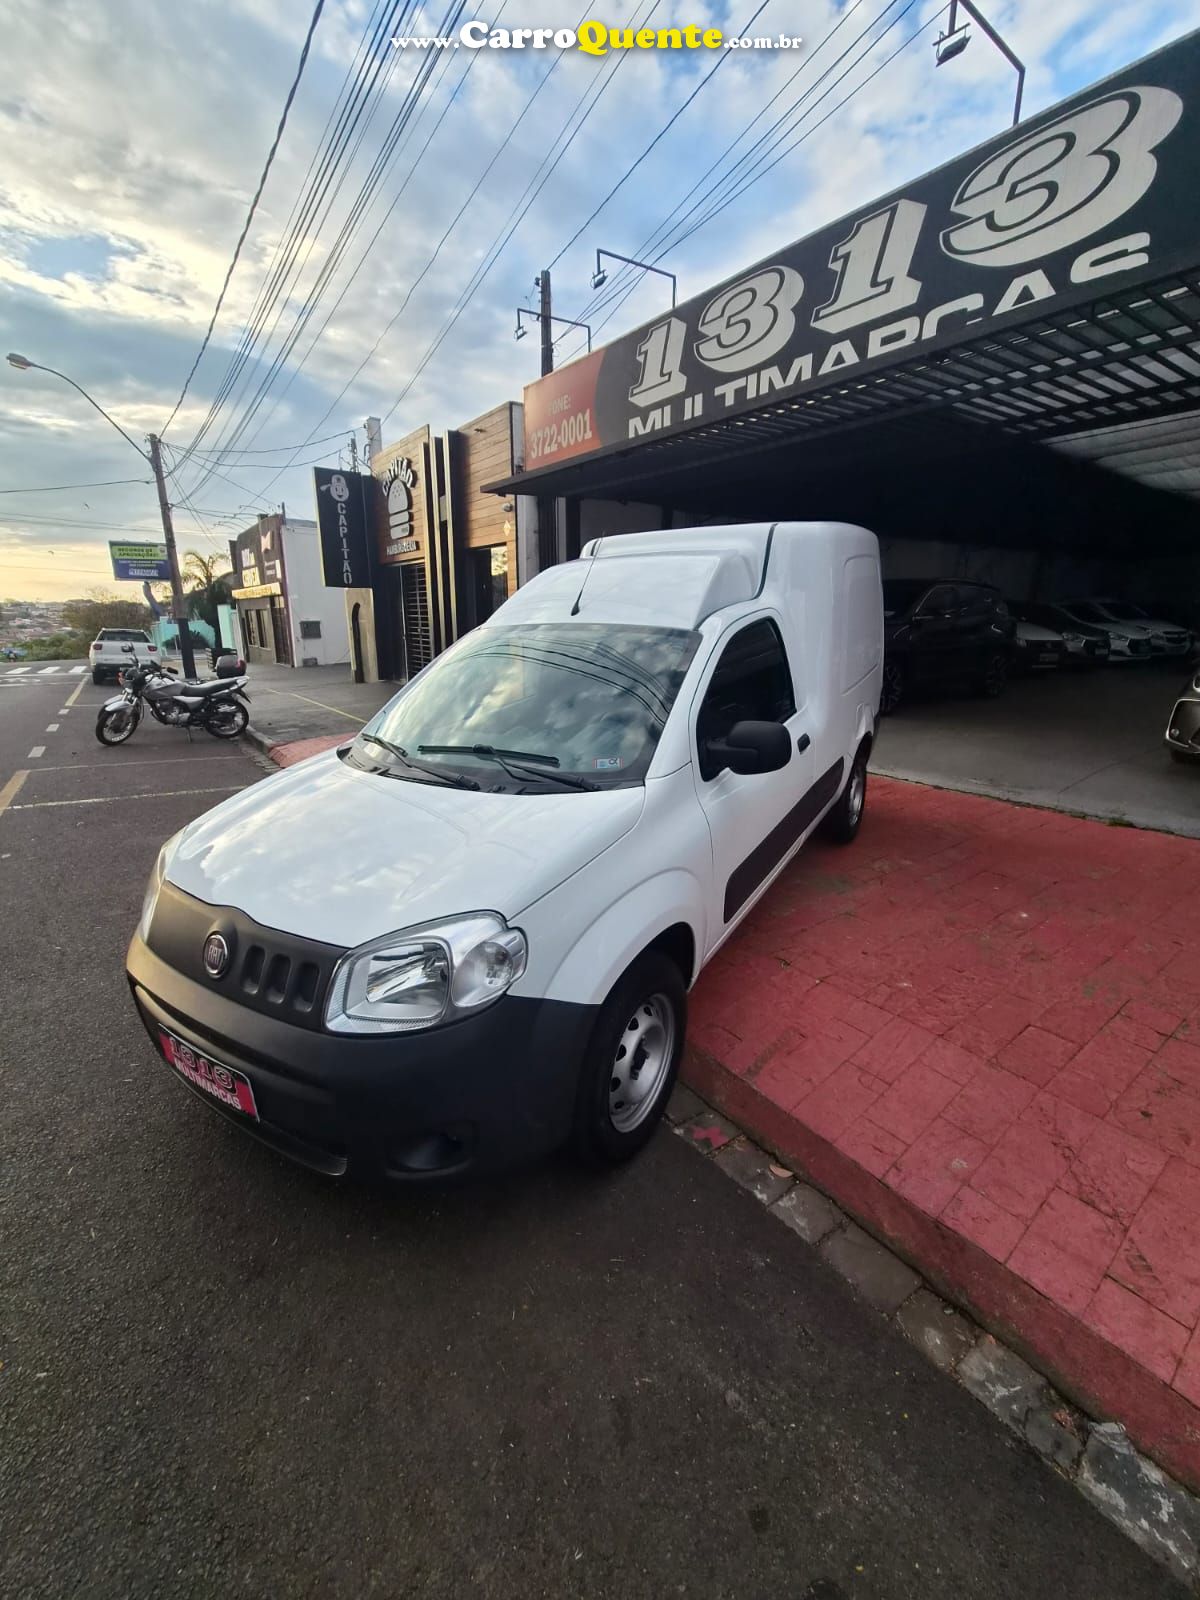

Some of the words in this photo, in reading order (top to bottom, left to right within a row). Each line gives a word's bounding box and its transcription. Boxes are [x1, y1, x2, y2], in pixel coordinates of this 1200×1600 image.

[629, 85, 1183, 408] 1313
[531, 408, 592, 459] 3722-0001
[208, 944, 224, 965] FIAT
[169, 1036, 238, 1097] 1313
